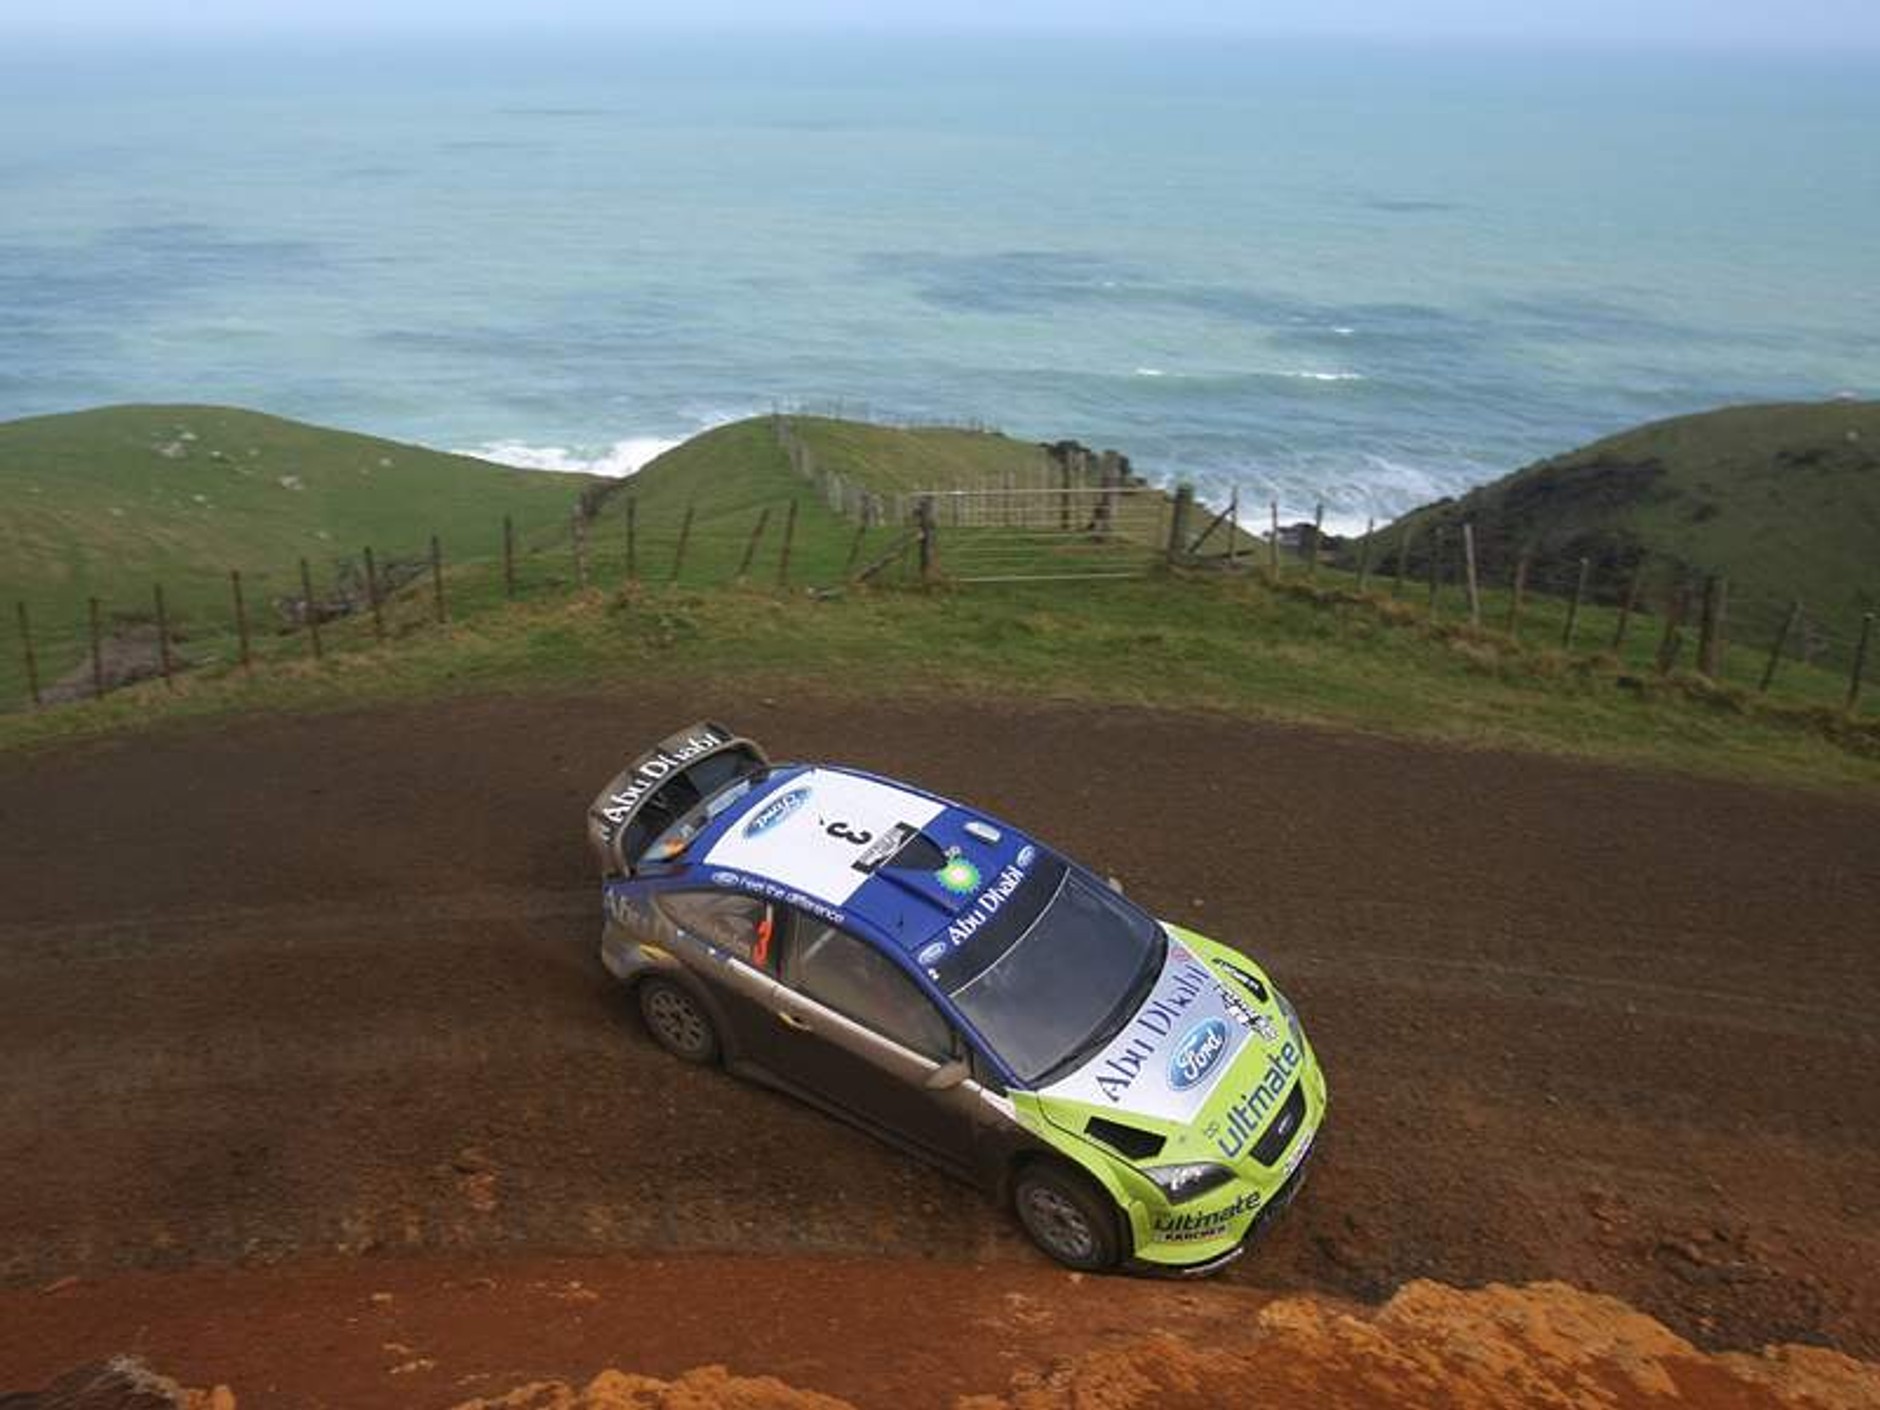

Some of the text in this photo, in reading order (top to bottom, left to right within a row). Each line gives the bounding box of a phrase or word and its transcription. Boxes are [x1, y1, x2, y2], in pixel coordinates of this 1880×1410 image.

[602, 732, 721, 823] Abu Dhabi
[826, 822, 873, 845] 3
[948, 865, 1024, 946] Abu Dhabi
[1095, 963, 1210, 1102] Abu Dhabi
[1178, 1028, 1224, 1079] Ford
[1217, 1041, 1299, 1158] ultimate
[1153, 1191, 1261, 1231] ultimate
